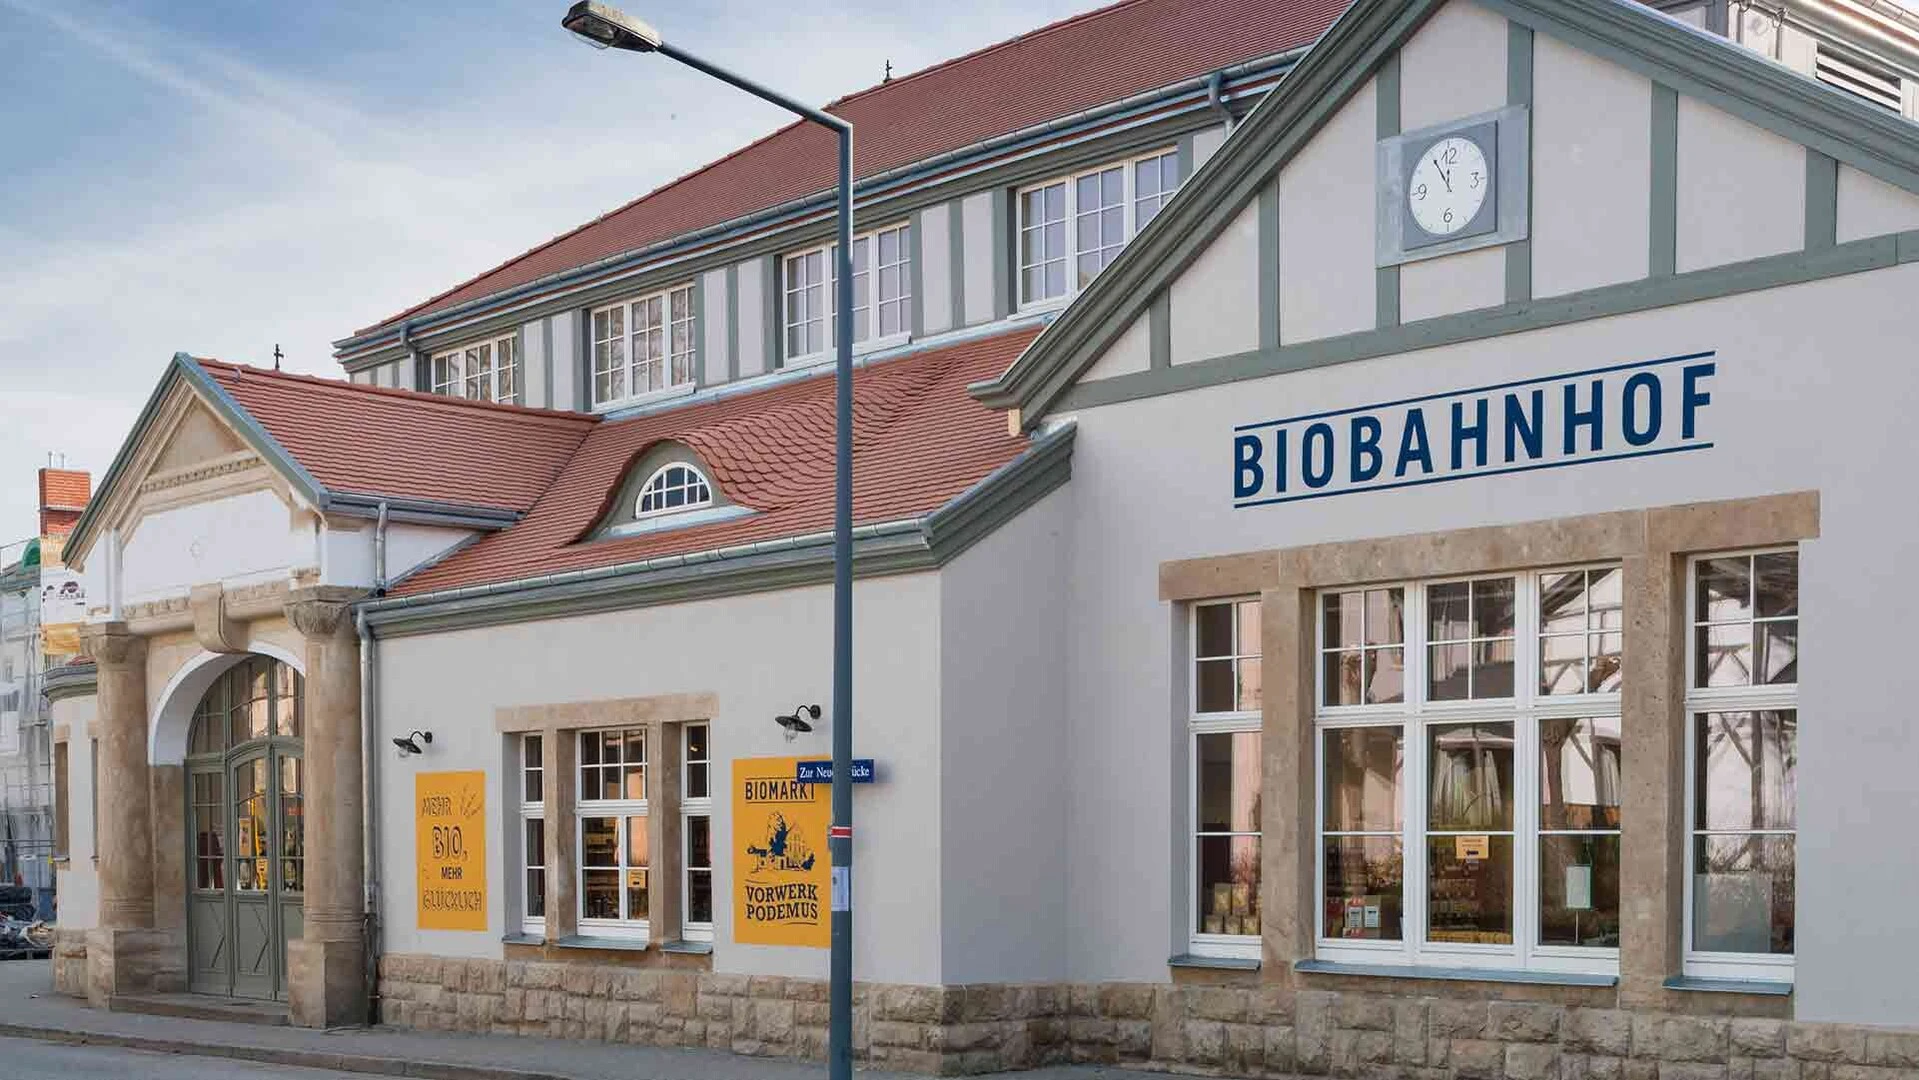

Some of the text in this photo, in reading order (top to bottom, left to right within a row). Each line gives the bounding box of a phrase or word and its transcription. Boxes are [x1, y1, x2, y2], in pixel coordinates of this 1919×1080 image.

[1441, 147, 1457, 165] 12
[1470, 171, 1480, 189] 3
[1417, 183, 1427, 201] 9
[1443, 207, 1453, 223] 6
[1234, 363, 1715, 498] BIOBAHNHOF
[800, 766, 814, 779] Zur
[745, 780, 815, 800] BIOMARKT
[441, 866, 463, 880] MEHR
[745, 883, 819, 902] VORWERK
[746, 902, 818, 921] PODEMUS
